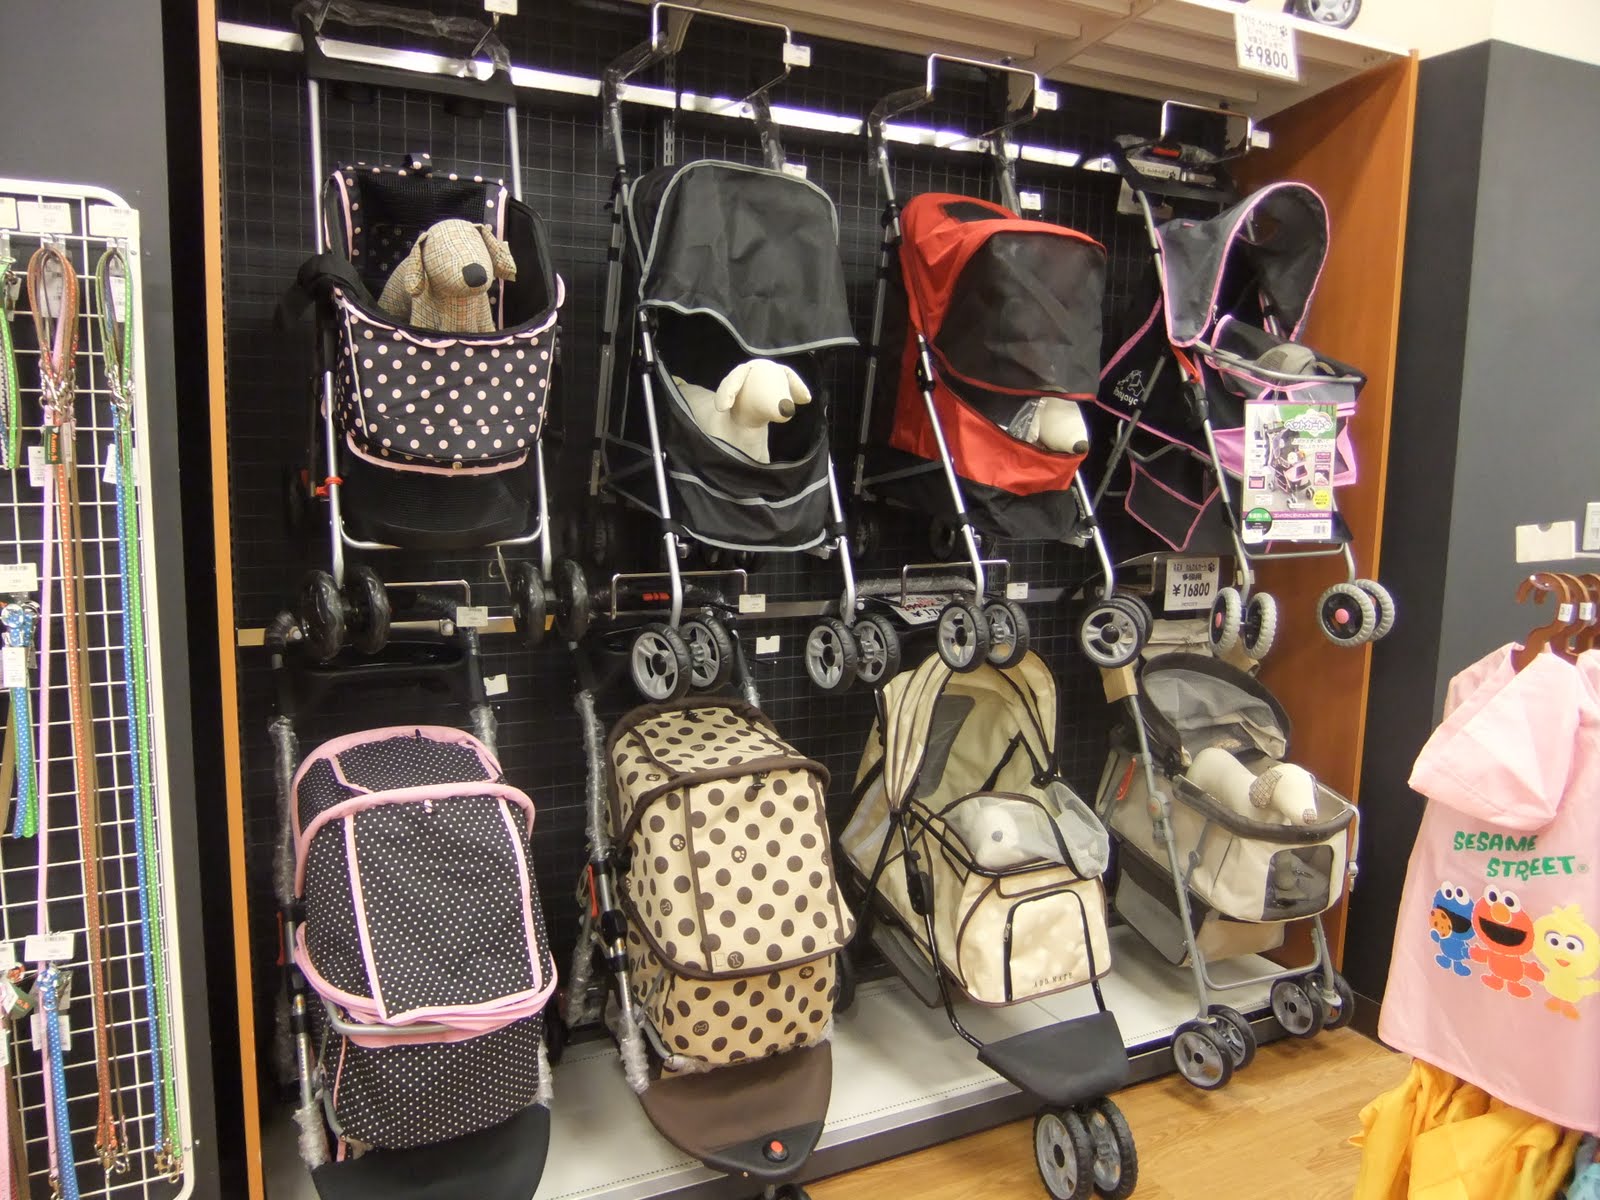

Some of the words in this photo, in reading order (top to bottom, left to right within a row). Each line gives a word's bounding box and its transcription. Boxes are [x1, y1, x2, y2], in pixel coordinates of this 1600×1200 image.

[1244, 43, 1289, 70] ¥9800
[1172, 582, 1211, 598] ¥16800
[1453, 830, 1538, 851] SESAME
[1486, 855, 1576, 881] STREET
